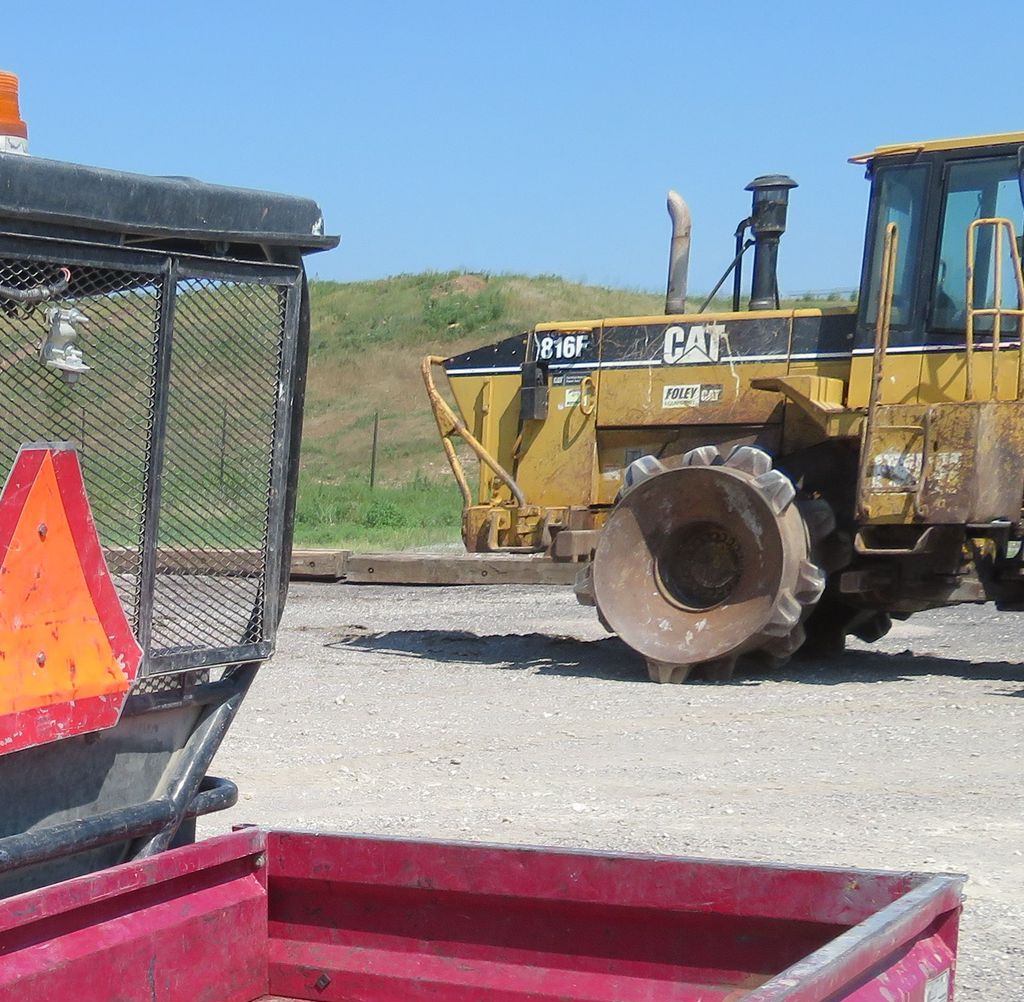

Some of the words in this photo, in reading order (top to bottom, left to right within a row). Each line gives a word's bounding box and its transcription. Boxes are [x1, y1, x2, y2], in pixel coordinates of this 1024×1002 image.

[540, 334, 588, 360] 816F
[664, 324, 726, 364] CAT
[665, 387, 698, 399] FOLEY
[701, 389, 722, 402] CAT
